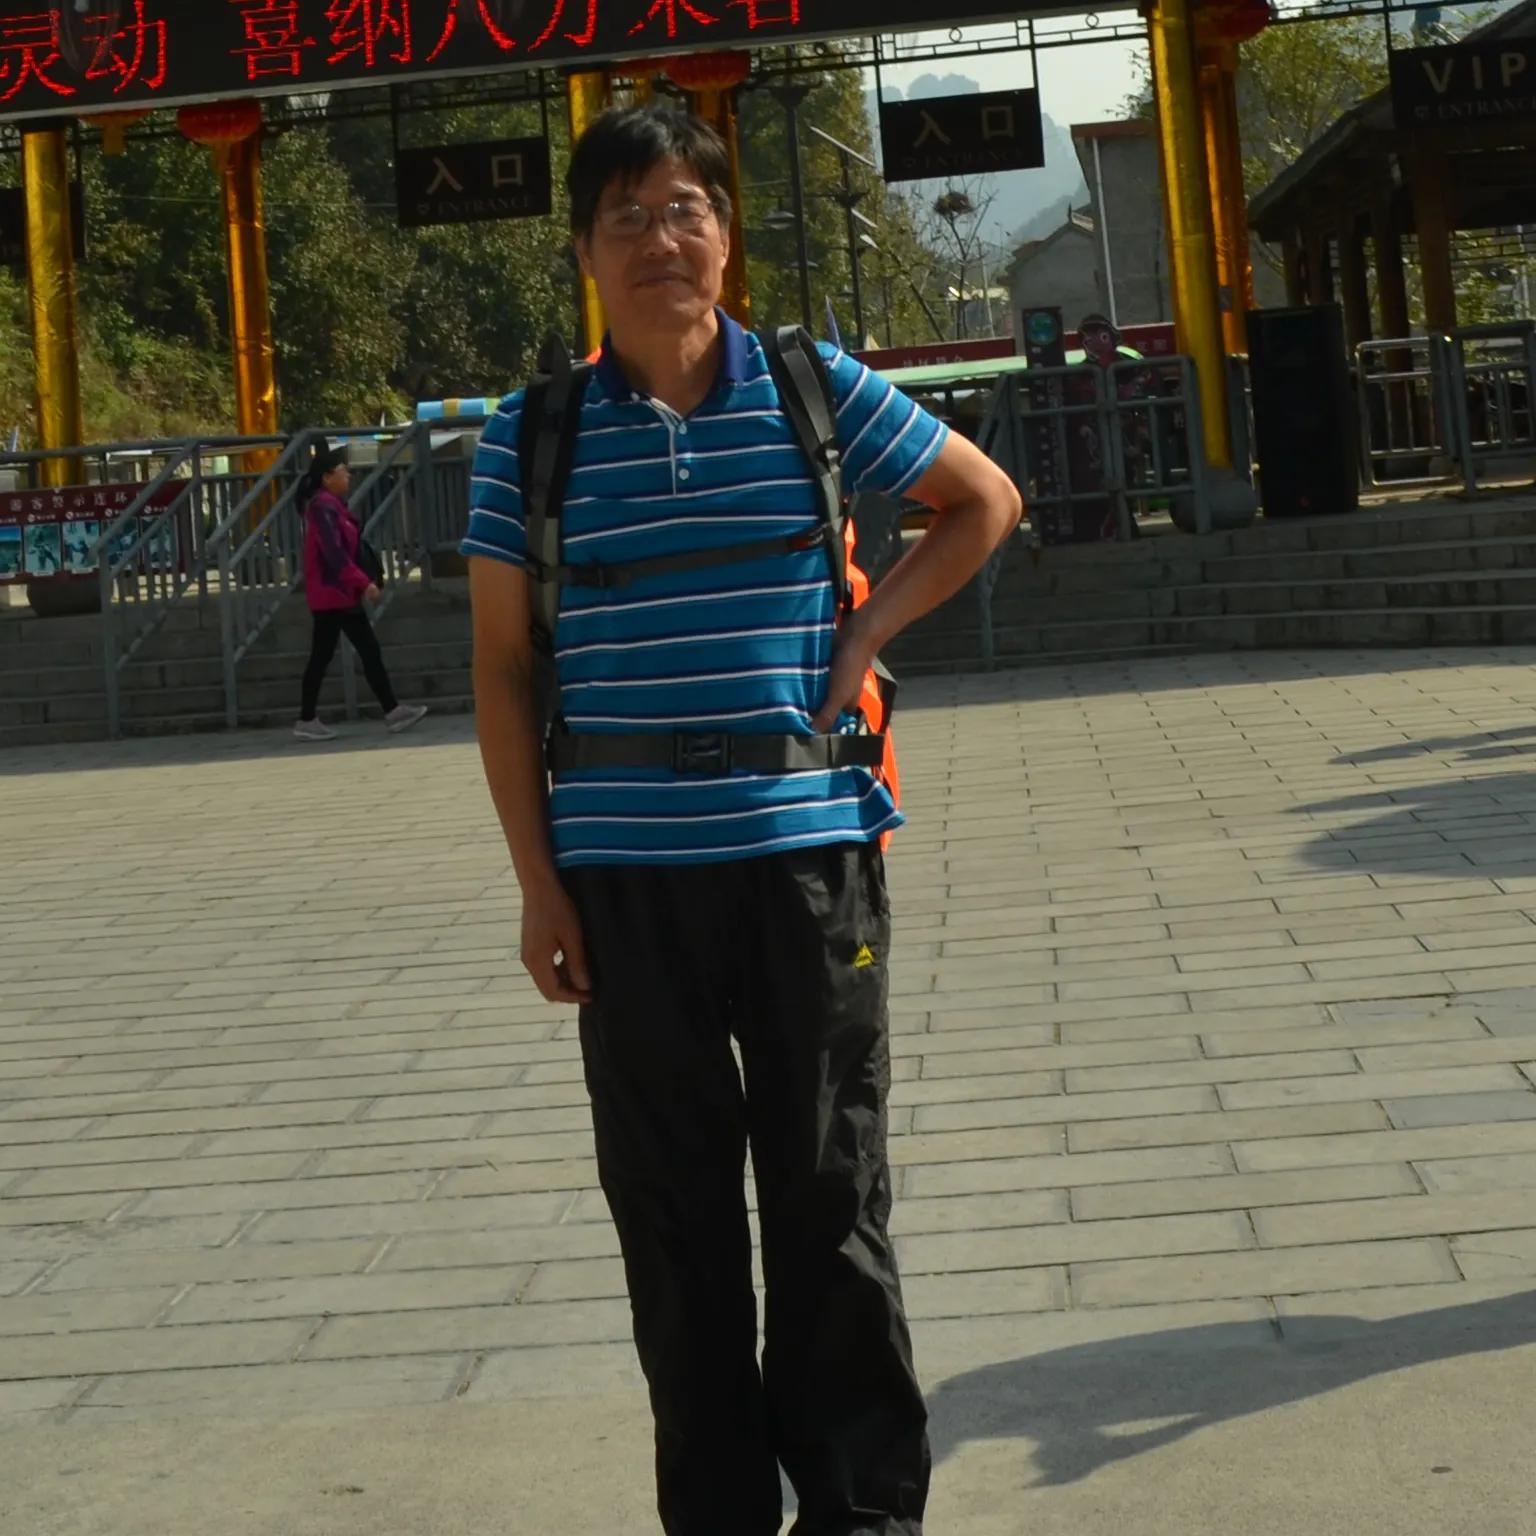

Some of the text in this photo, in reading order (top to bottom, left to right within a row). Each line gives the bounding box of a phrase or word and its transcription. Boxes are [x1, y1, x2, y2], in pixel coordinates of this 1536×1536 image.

[1421, 51, 1528, 94] VIP
[912, 105, 1015, 148] 入口
[425, 153, 524, 195] 入口
[437, 195, 531, 216] ENTRANCE
[10, 491, 141, 512] 游客警示连环
